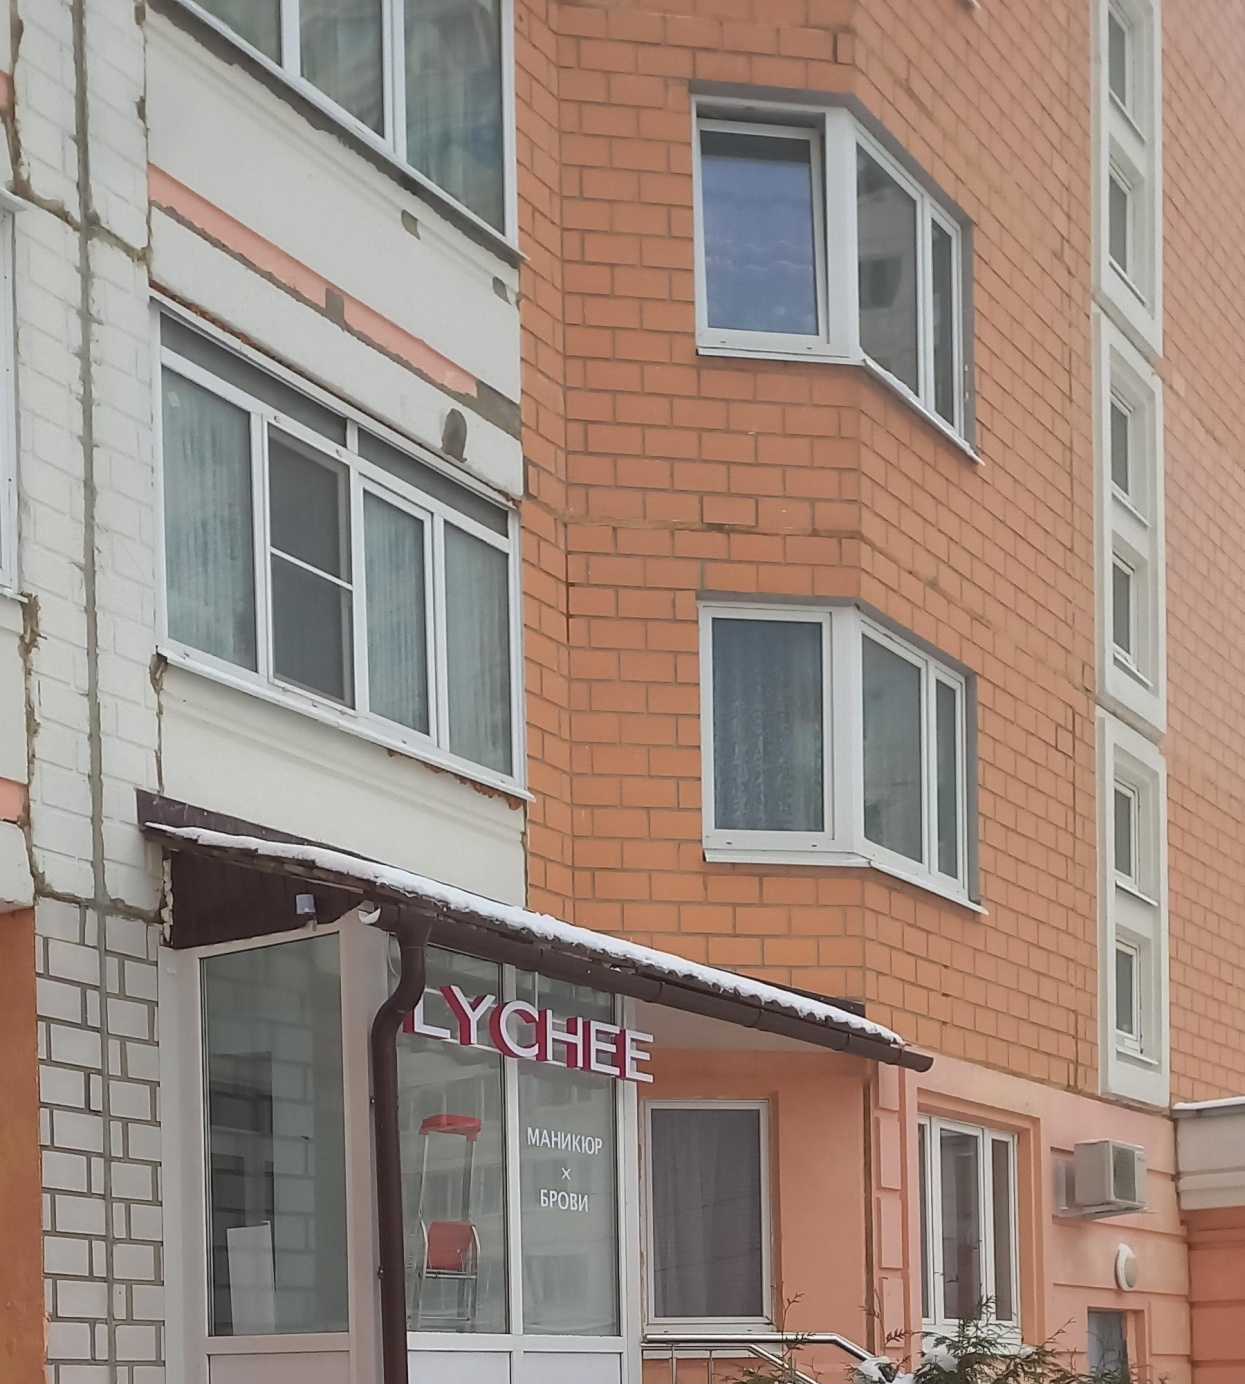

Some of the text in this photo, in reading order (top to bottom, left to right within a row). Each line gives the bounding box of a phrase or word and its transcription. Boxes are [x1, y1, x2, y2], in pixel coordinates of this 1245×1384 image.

[405, 984, 654, 1083] LYCHEE
[527, 1127, 603, 1155] МАНИКЮР
[540, 1189, 589, 1212] БРОВИ
